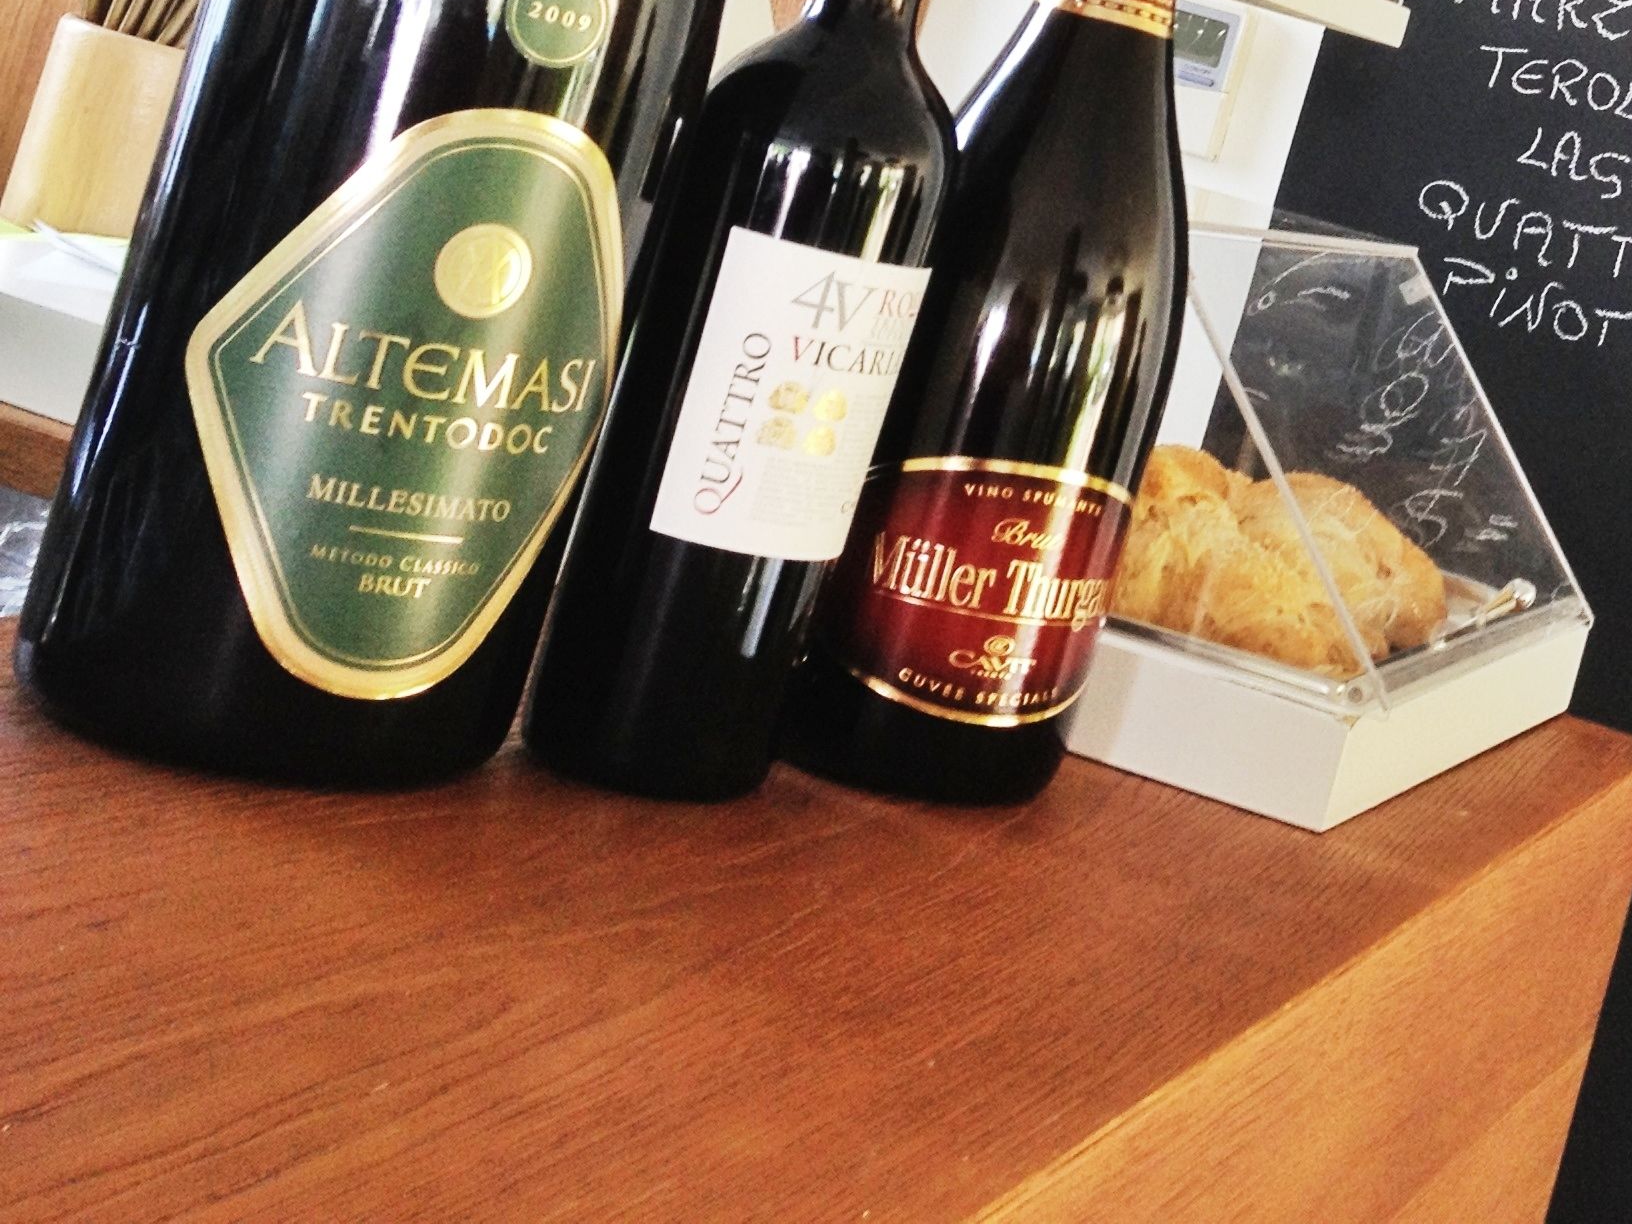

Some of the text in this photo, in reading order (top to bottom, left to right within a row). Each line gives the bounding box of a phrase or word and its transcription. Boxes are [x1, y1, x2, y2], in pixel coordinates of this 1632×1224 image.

[528, 1, 593, 33] 2009
[878, 289, 917, 319] RO
[249, 299, 596, 414] ALTEMASI
[301, 391, 553, 455] TRENTODOC
[694, 332, 772, 516] QUATTRO
[307, 474, 511, 523] MILLESIMATO
[964, 483, 1102, 516] VINO SPUMNTE
[991, 517, 1062, 550] Bru
[309, 544, 481, 576] METODO CLASSICO
[872, 531, 997, 610] Müller
[358, 574, 431, 599] BRUT
